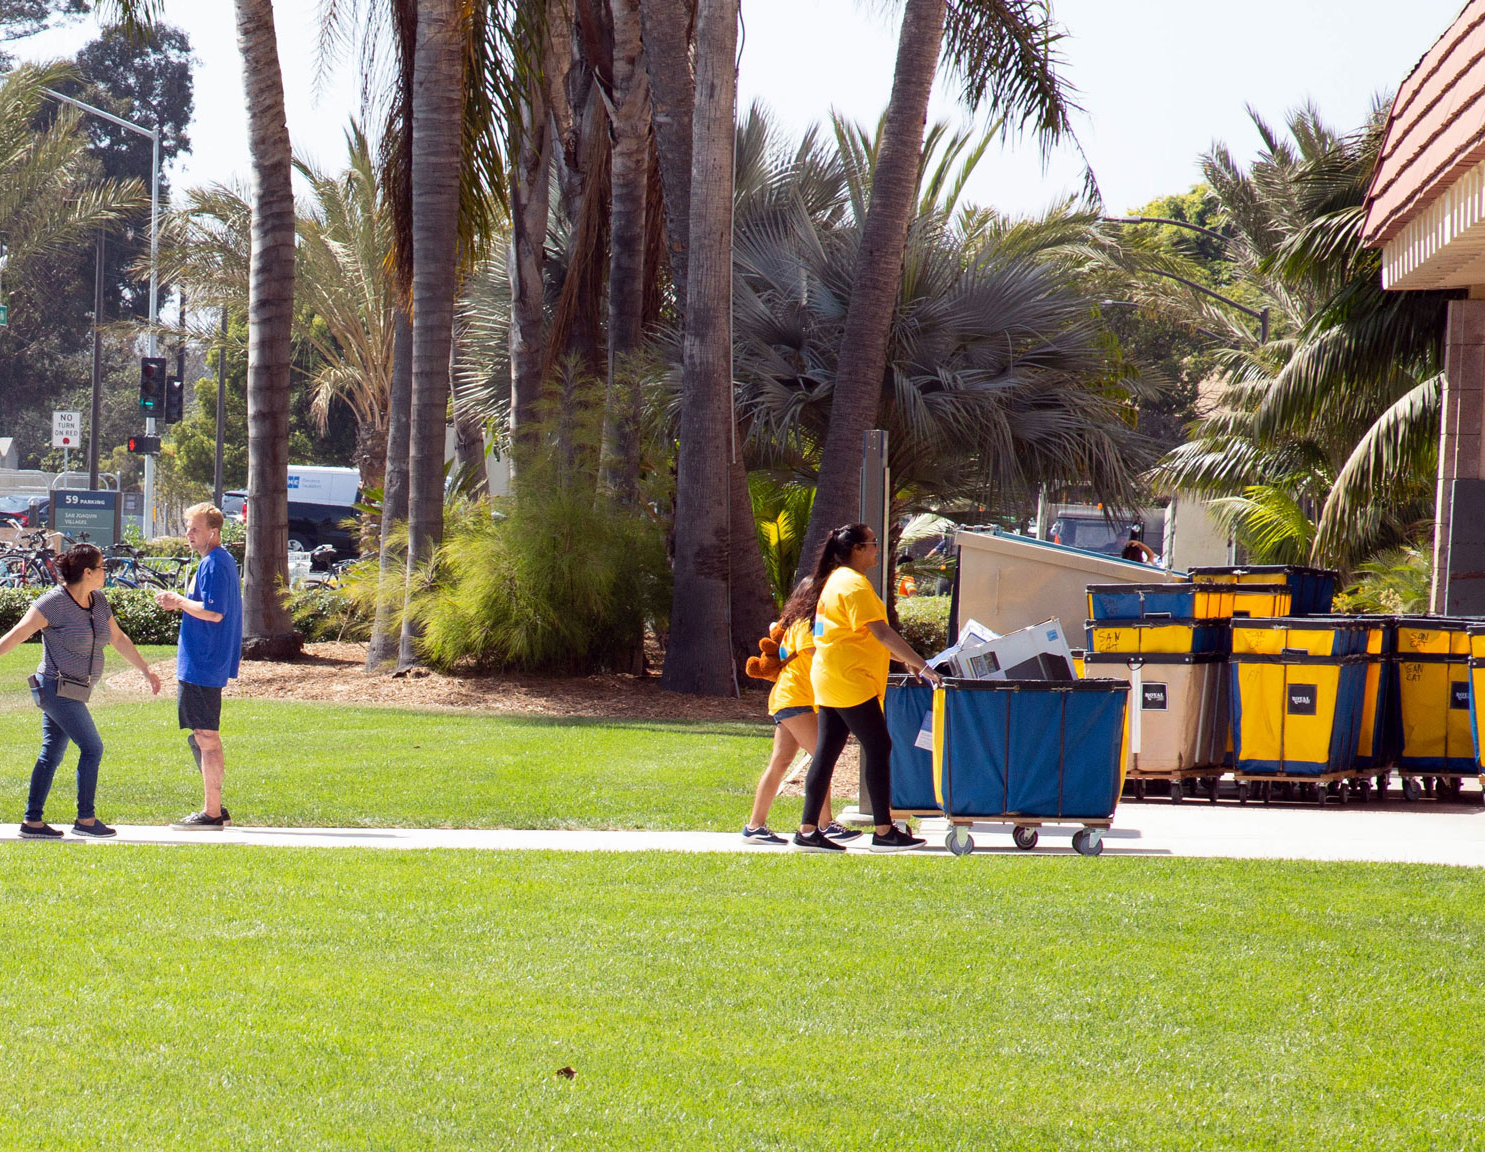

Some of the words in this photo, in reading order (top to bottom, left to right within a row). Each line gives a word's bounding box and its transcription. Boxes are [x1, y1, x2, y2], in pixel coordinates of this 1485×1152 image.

[65, 495, 79, 504] 59
[1098, 631, 1121, 642] SAN
[1410, 631, 1429, 641] SAN
[1406, 664, 1423, 673] SAN
[1406, 673, 1421, 681] CAT
[1145, 692, 1164, 700] ROYAL
